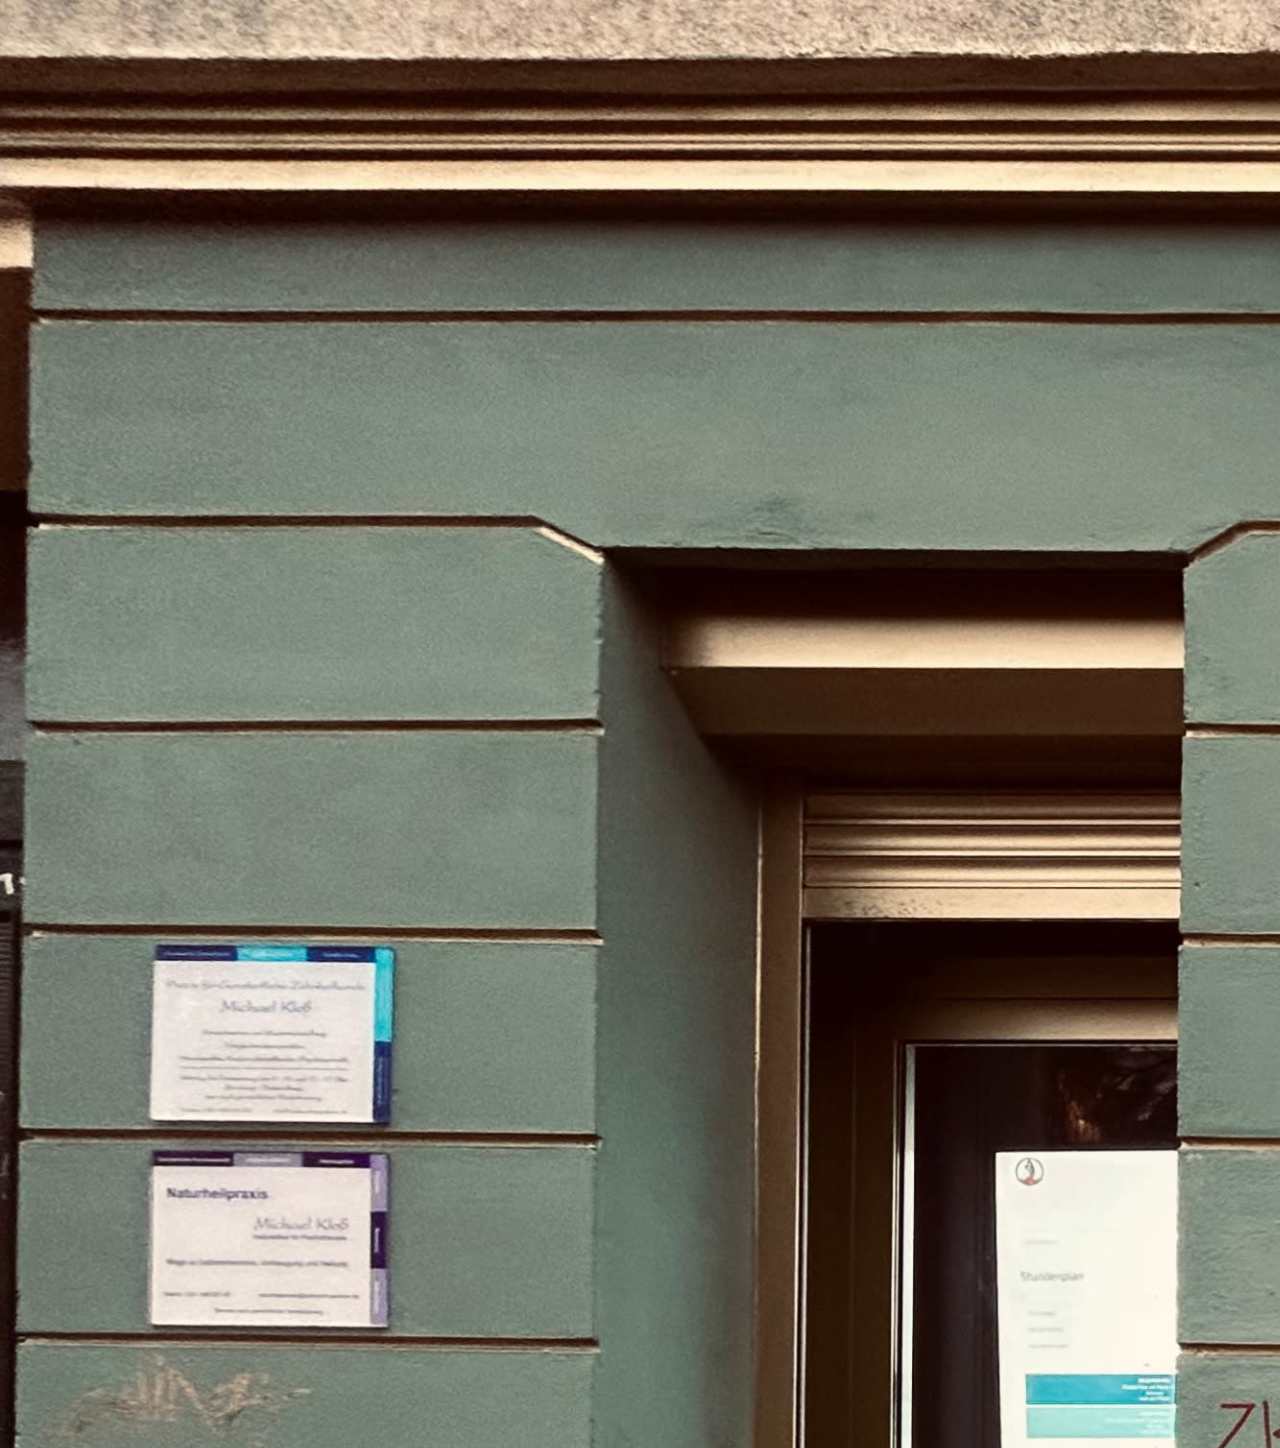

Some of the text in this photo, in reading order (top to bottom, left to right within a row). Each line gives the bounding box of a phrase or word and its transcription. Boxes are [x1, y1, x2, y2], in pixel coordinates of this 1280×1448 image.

[219, 1000, 276, 1014] Michael
[166, 1187, 269, 1201] Naturheilpraxis
[253, 1216, 311, 1231] Michael
